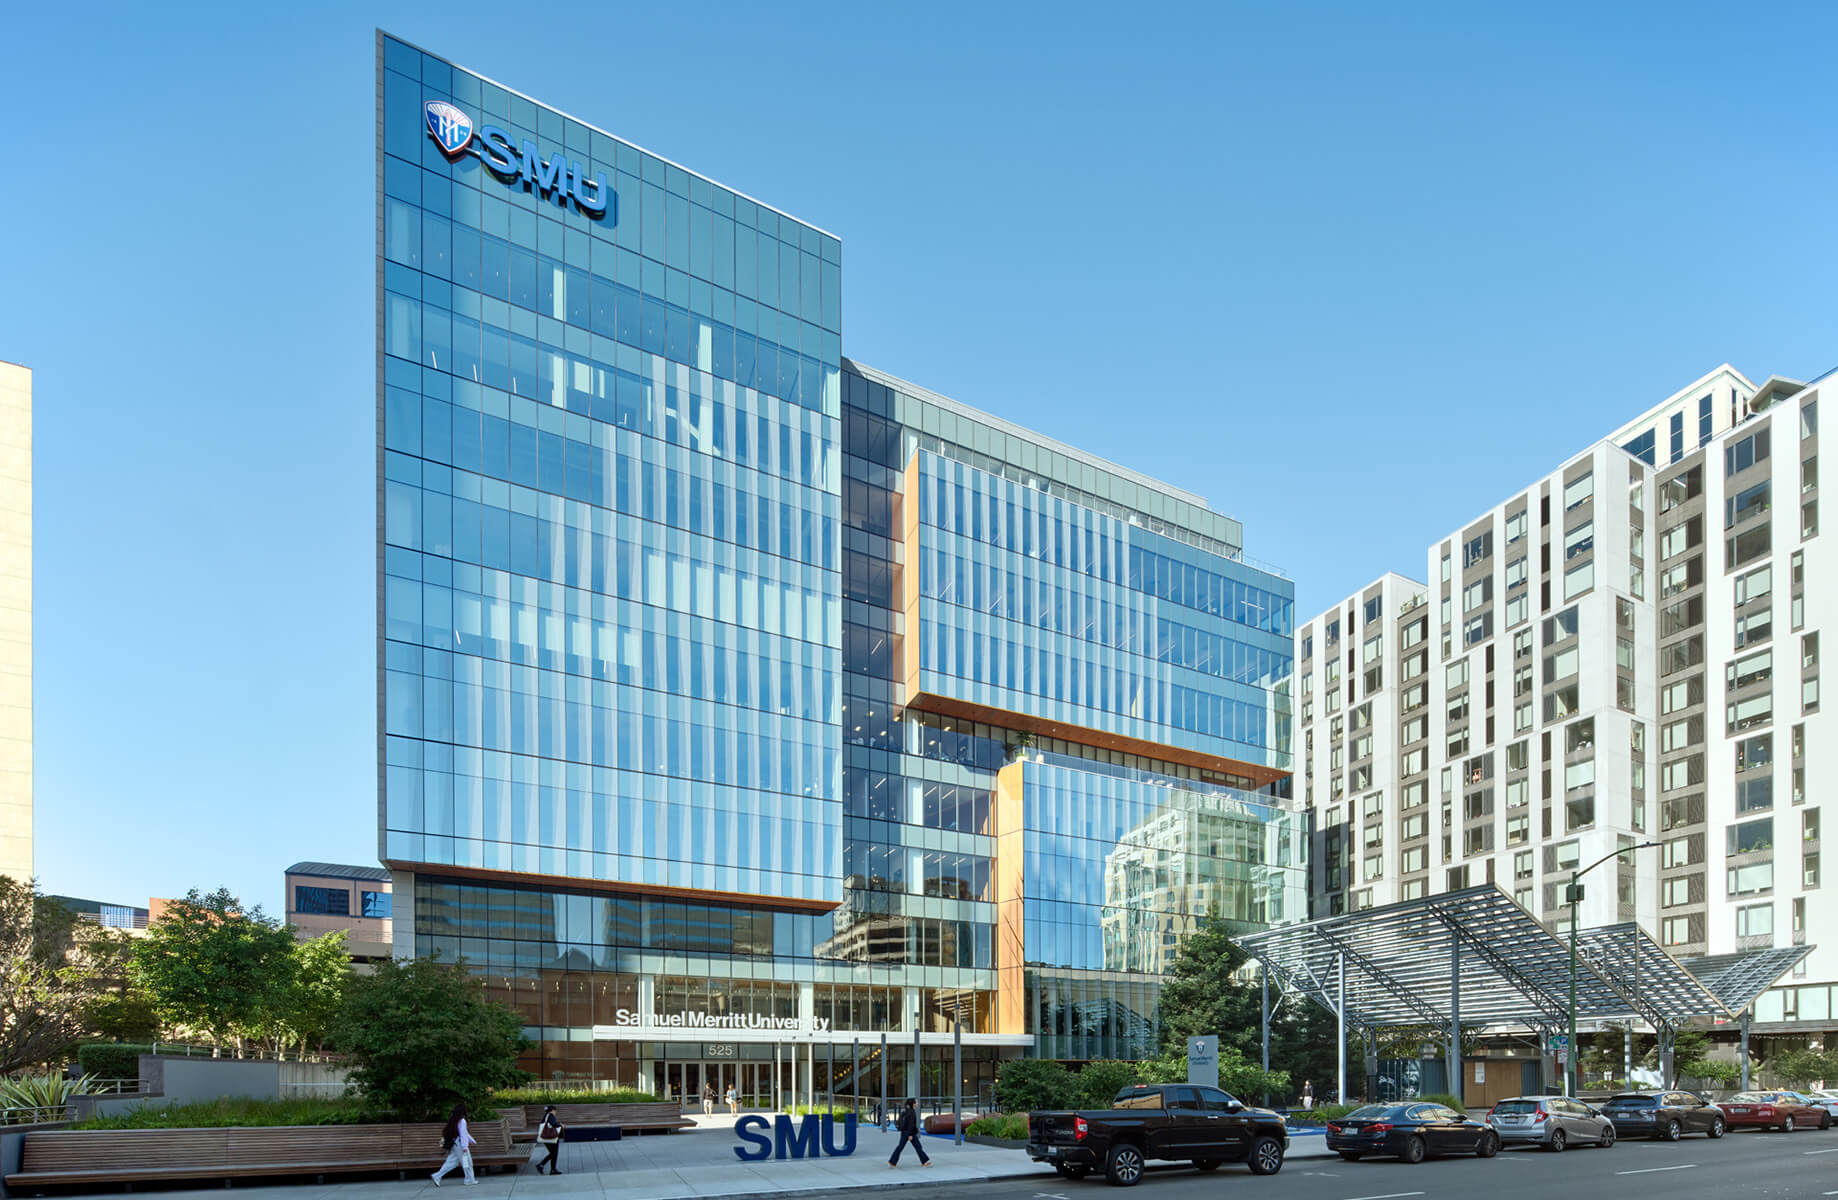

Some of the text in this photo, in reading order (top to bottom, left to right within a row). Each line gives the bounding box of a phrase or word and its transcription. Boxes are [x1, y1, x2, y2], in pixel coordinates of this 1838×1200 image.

[480, 124, 607, 214] SMU
[688, 1011, 747, 1029] Merritt
[748, 1013, 829, 1031] Univerty
[708, 1045, 733, 1056] 525
[733, 1113, 856, 1161] SMU
